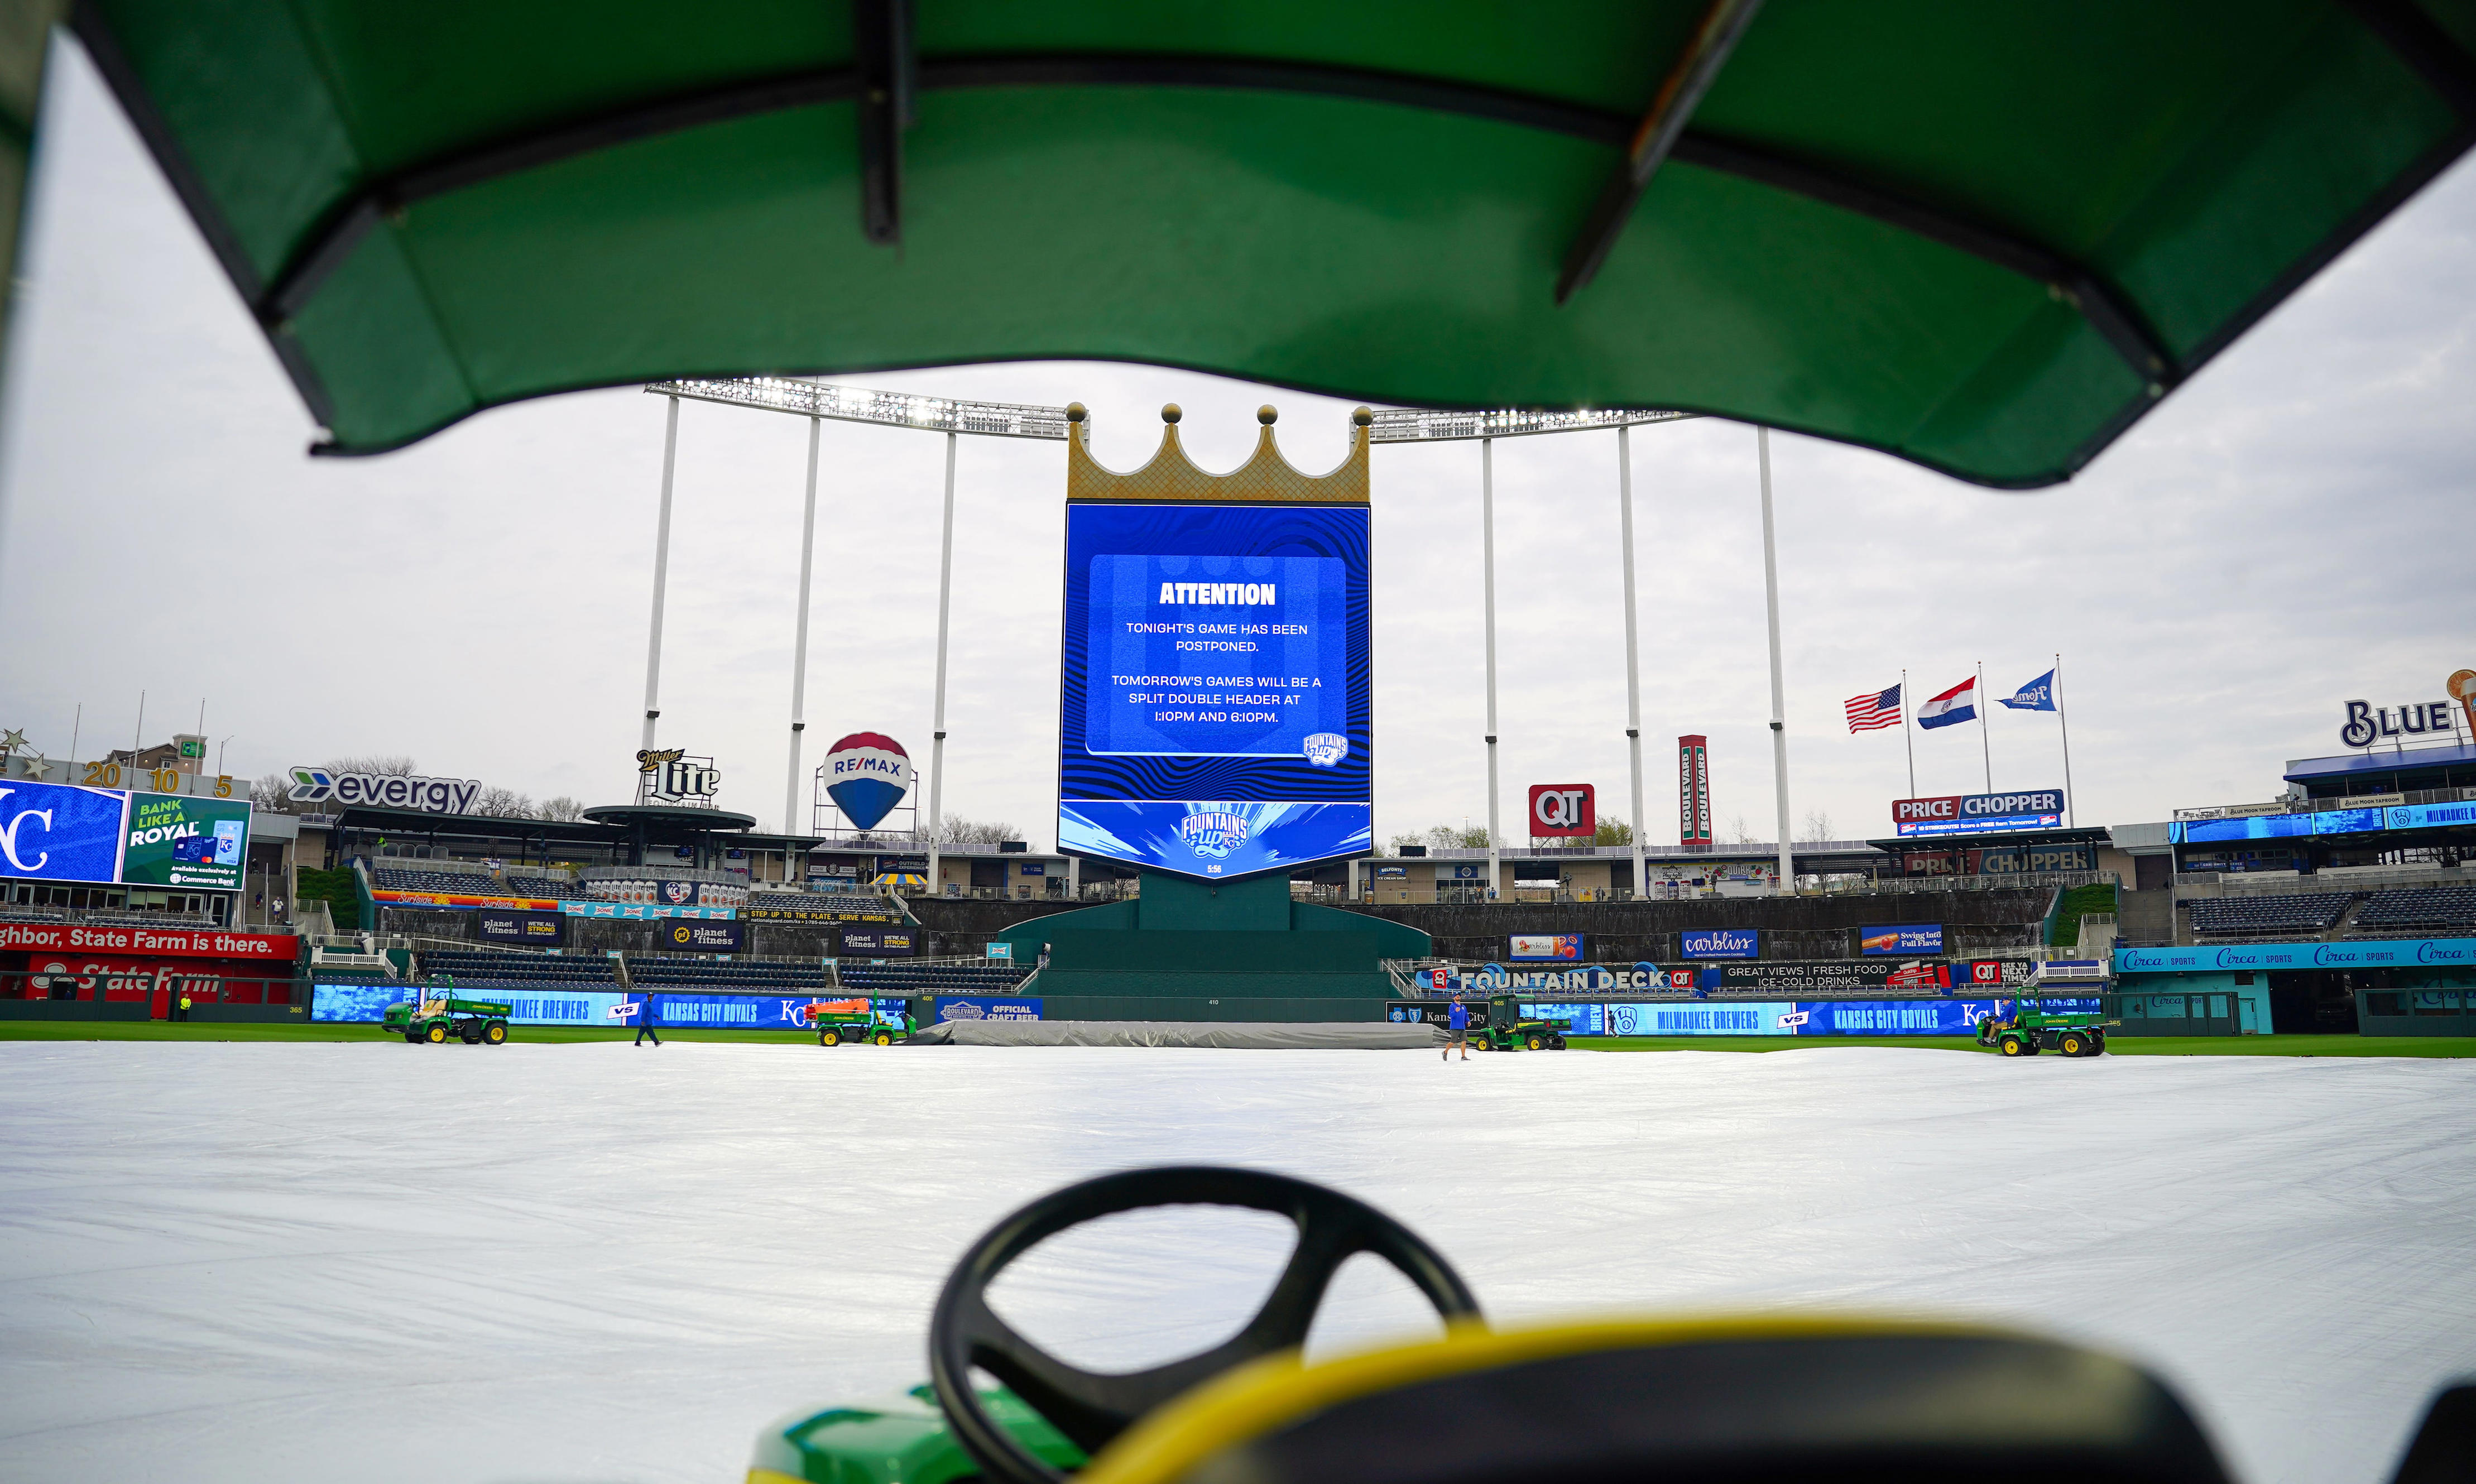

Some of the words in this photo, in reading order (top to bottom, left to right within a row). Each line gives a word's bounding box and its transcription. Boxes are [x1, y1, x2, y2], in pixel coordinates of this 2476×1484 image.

[1159, 583, 1275, 606] ATTENTION
[1126, 623, 1195, 634] TONIGHT'S
[1198, 623, 1237, 635] GAME
[1241, 624, 1269, 635] HAS
[1272, 625, 1308, 635] BEEN
[1175, 641, 1259, 652] POSTPONED.
[1112, 675, 1203, 687] TOMORROW'S
[1206, 676, 1254, 688] GAMES
[1257, 677, 1287, 688] WILL
[1291, 677, 1309, 688] BE
[1312, 677, 1322, 688] A
[1129, 693, 1165, 704] SPLIT
[1168, 693, 1222, 705] DOUBLE
[1225, 694, 1281, 705] HEADER
[1283, 694, 1301, 705] AT
[1198, 712, 1227, 722] AND
[1230, 712, 1279, 723] 6:10PM.
[2341, 700, 2453, 748] BLUE
[1305, 734, 1346, 752] FOUNTAINS
[637, 749, 683, 768] Miller
[835, 757, 901, 777] RE/MAX
[83, 761, 121, 787] 20
[148, 767, 179, 793] 10
[651, 761, 721, 802] Lite
[214, 775, 233, 798] 5
[338, 777, 476, 814] evergy
[1682, 753, 1692, 831] BOULEVARD
[1697, 753, 1709, 831] BOULEVARD
[140, 799, 183, 815] BANK
[1535, 790, 1584, 828] QT
[1899, 800, 1953, 819] PRICE
[1964, 793, 2057, 815] CHOPPER
[2426, 807, 2469, 823] MILWAUKEE
[138, 815, 171, 828] LIKE
[174, 811, 185, 822] A
[1183, 812, 1247, 839] FOUNTAINS
[129, 822, 200, 847] ROYAL
[198, 867, 230, 875] exclusively
[1207, 865, 1222, 873] 5:56
[181, 875, 217, 884] Commerce
[397, 893, 433, 904] Surfside
[480, 898, 514, 909] Surfside
[483, 919, 513, 930] planet
[693, 927, 727, 939] planet
[70, 929, 128, 947] State
[133, 931, 187, 949] Farm
[193, 934, 209, 950] is
[214, 935, 273, 953] there.
[678, 930, 686, 939] pf
[697, 935, 733, 945] fitness
[845, 934, 871, 943] planet
[1685, 931, 1754, 952] carbliss
[1901, 932, 1925, 940] Swing
[2123, 950, 2164, 971] Circa
[2170, 957, 2196, 966] SPORTS
[2216, 947, 2259, 968] Circa
[2266, 954, 2292, 963] SPORTS
[2314, 944, 2359, 966] Circa
[2366, 952, 2394, 960] SPORTS
[2417, 942, 2465, 963] Circa
[1434, 971, 1445, 986] QT
[1728, 967, 1765, 977] GREAT
[1767, 967, 1804, 976] VIEWS
[1813, 966, 1851, 975] FRESH
[1854, 965, 1887, 974] FOOD
[1975, 964, 1995, 981] QT
[1460, 972, 1590, 990] FOUNTAIN
[1597, 971, 1666, 989] DECK
[1673, 972, 1691, 985] QT
[1758, 977, 1814, 987] ICE-COLD
[1817, 976, 1860, 986] DRINKS
[542, 1000, 589, 1020] BREWERS
[663, 1002, 699, 1022] KANSAS
[702, 1003, 722, 1022] CITY
[724, 1004, 757, 1022] ROYALS
[780, 1000, 806, 1027] KC
[947, 1007, 978, 1017] BOULEVARD
[992, 1005, 1031, 1014] OFFICIAL
[1468, 1012, 1486, 1024] City
[1657, 1011, 1712, 1030] MILWAUKEE
[1714, 1010, 1759, 1029] BREWERS
[1834, 1010, 1874, 1029] KANSAS
[1876, 1010, 1898, 1029] CITY
[1901, 1009, 1938, 1029] ROYALS
